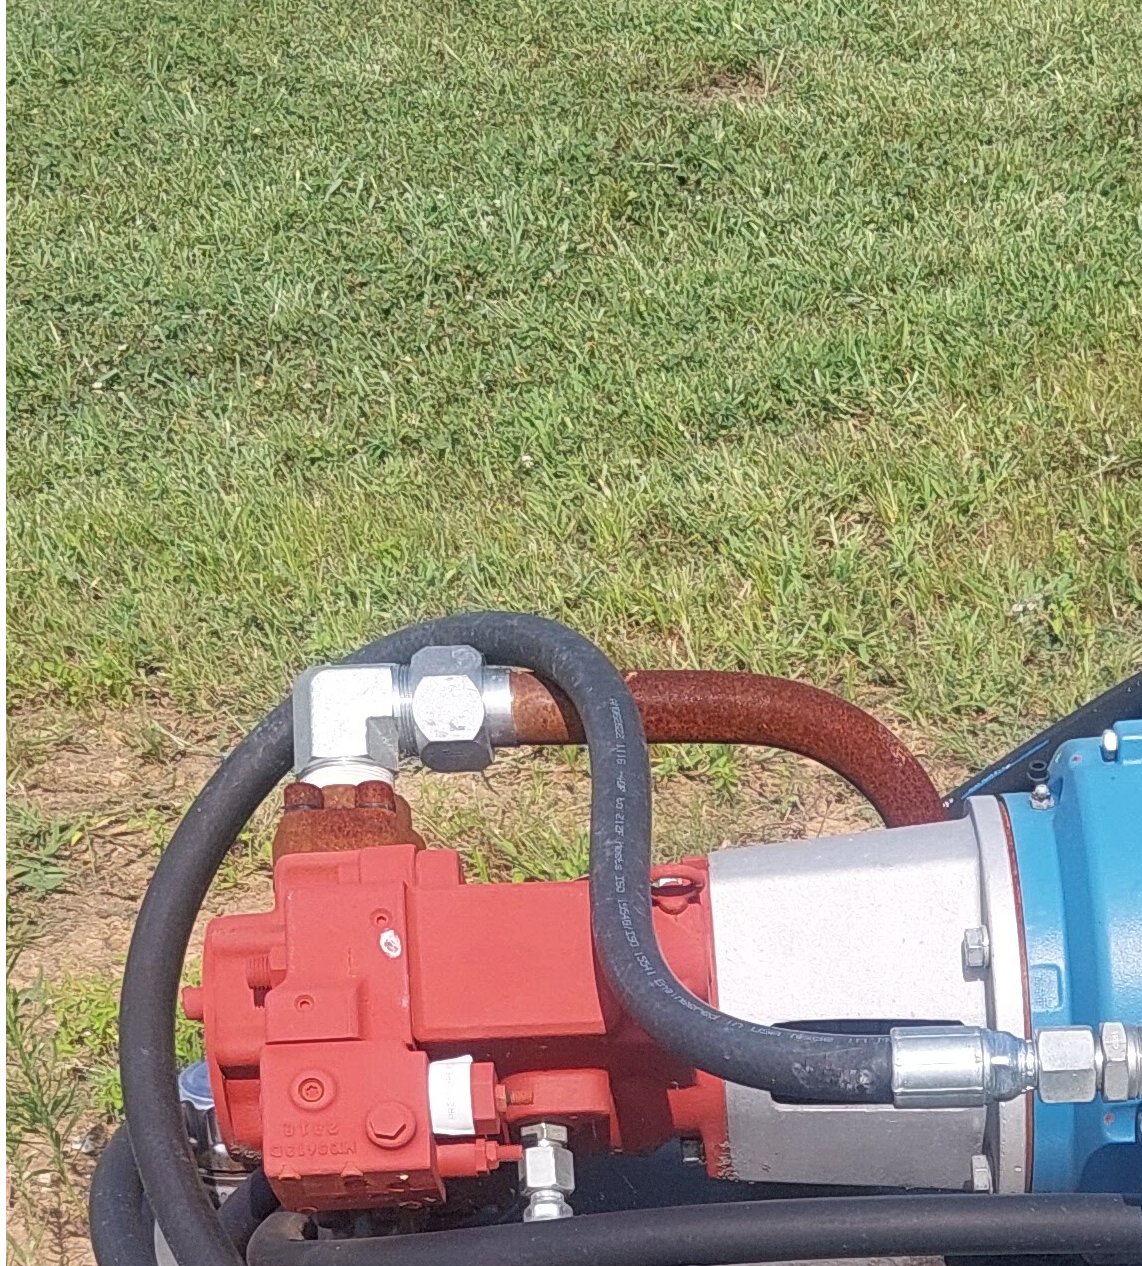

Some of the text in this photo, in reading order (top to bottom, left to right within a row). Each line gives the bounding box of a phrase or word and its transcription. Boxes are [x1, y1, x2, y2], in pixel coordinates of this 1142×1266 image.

[615, 797, 626, 809] to
[614, 813, 625, 837] 212F
[615, 875, 626, 893] ISO
[633, 951, 656, 976] 15541
